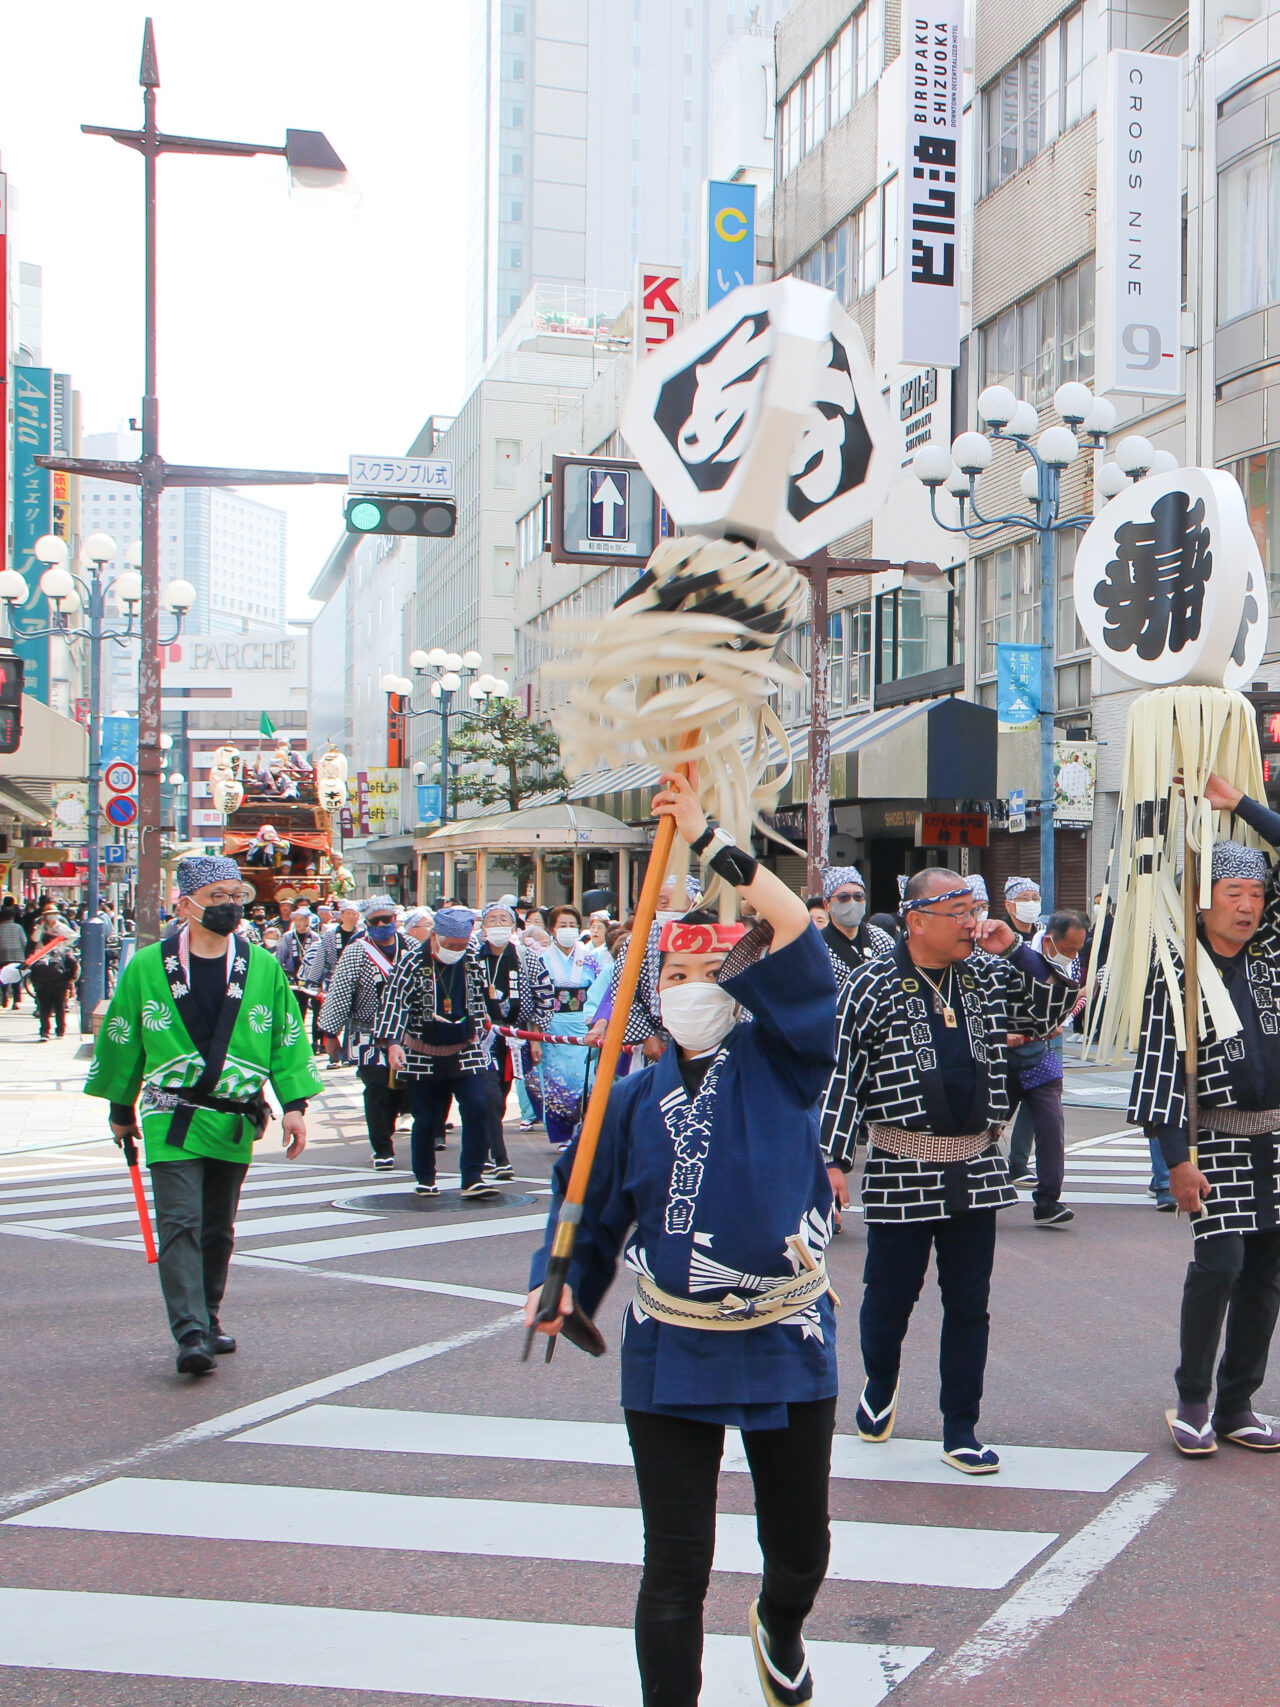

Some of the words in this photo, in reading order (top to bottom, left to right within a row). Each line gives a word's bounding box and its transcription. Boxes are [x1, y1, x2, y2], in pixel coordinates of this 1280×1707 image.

[915, 19, 929, 124] BIRUPAKU
[933, 22, 949, 127] SHIZUOKA
[1128, 68, 1143, 190] CROSS
[1127, 210, 1142, 296] NINE
[17, 372, 49, 447] Aria
[354, 461, 450, 487] スクランブル式
[111, 770, 130, 785] 30
[110, 846, 122, 859] P
